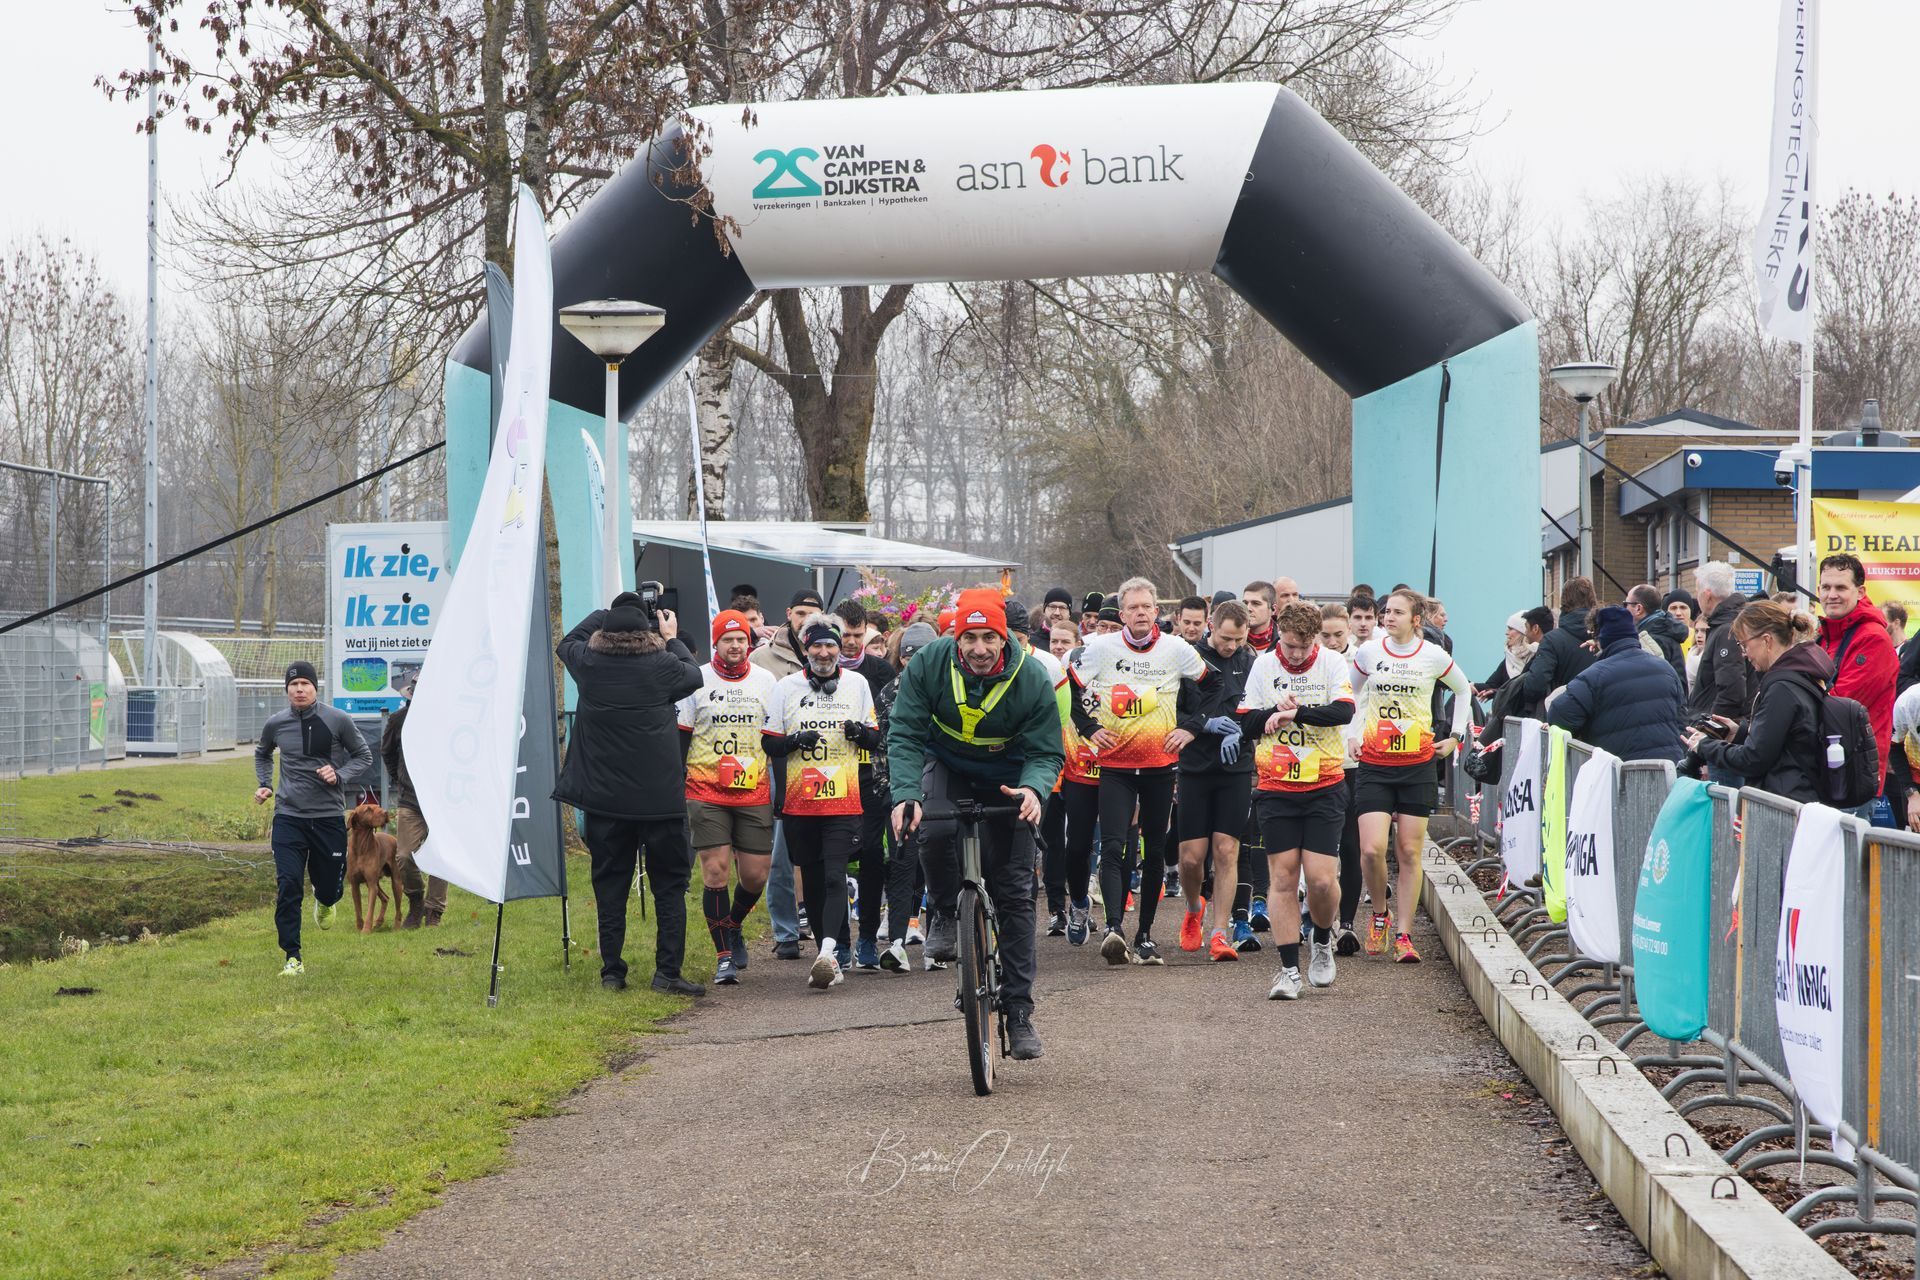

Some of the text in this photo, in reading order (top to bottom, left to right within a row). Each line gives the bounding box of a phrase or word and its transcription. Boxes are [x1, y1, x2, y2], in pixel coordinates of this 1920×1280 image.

[823, 144, 865, 160] VAN
[823, 158, 926, 178] CAMPEN &
[956, 145, 1184, 192] asn bank
[824, 176, 920, 196] DIJKSTRA
[753, 195, 928, 211] Verzekeringen Bankzaken Hypotheken
[1827, 535, 1857, 552] DE
[343, 543, 440, 582] Ik zie,
[1867, 567, 1907, 575] LEUKSTE
[344, 592, 430, 627] Ik zie
[345, 638, 366, 648] Wat
[368, 637, 377, 651] jij
[380, 637, 399, 648] niet
[401, 636, 420, 647] ziet
[1133, 661, 1151, 669] HdB
[1133, 668, 1167, 676] Logistics
[726, 688, 743, 696] HdB
[1290, 683, 1326, 692] Logistics
[1376, 684, 1417, 693] NOCHT
[726, 696, 760, 704] Logistics
[816, 701, 850, 710] Logistics
[1125, 698, 1142, 715] 411
[711, 714, 754, 724] NOCHT
[1389, 734, 1406, 751] 191
[1085, 760, 1100, 776] 36
[1287, 761, 1301, 780] 19
[733, 769, 747, 787] 52
[813, 780, 836, 798] 249
